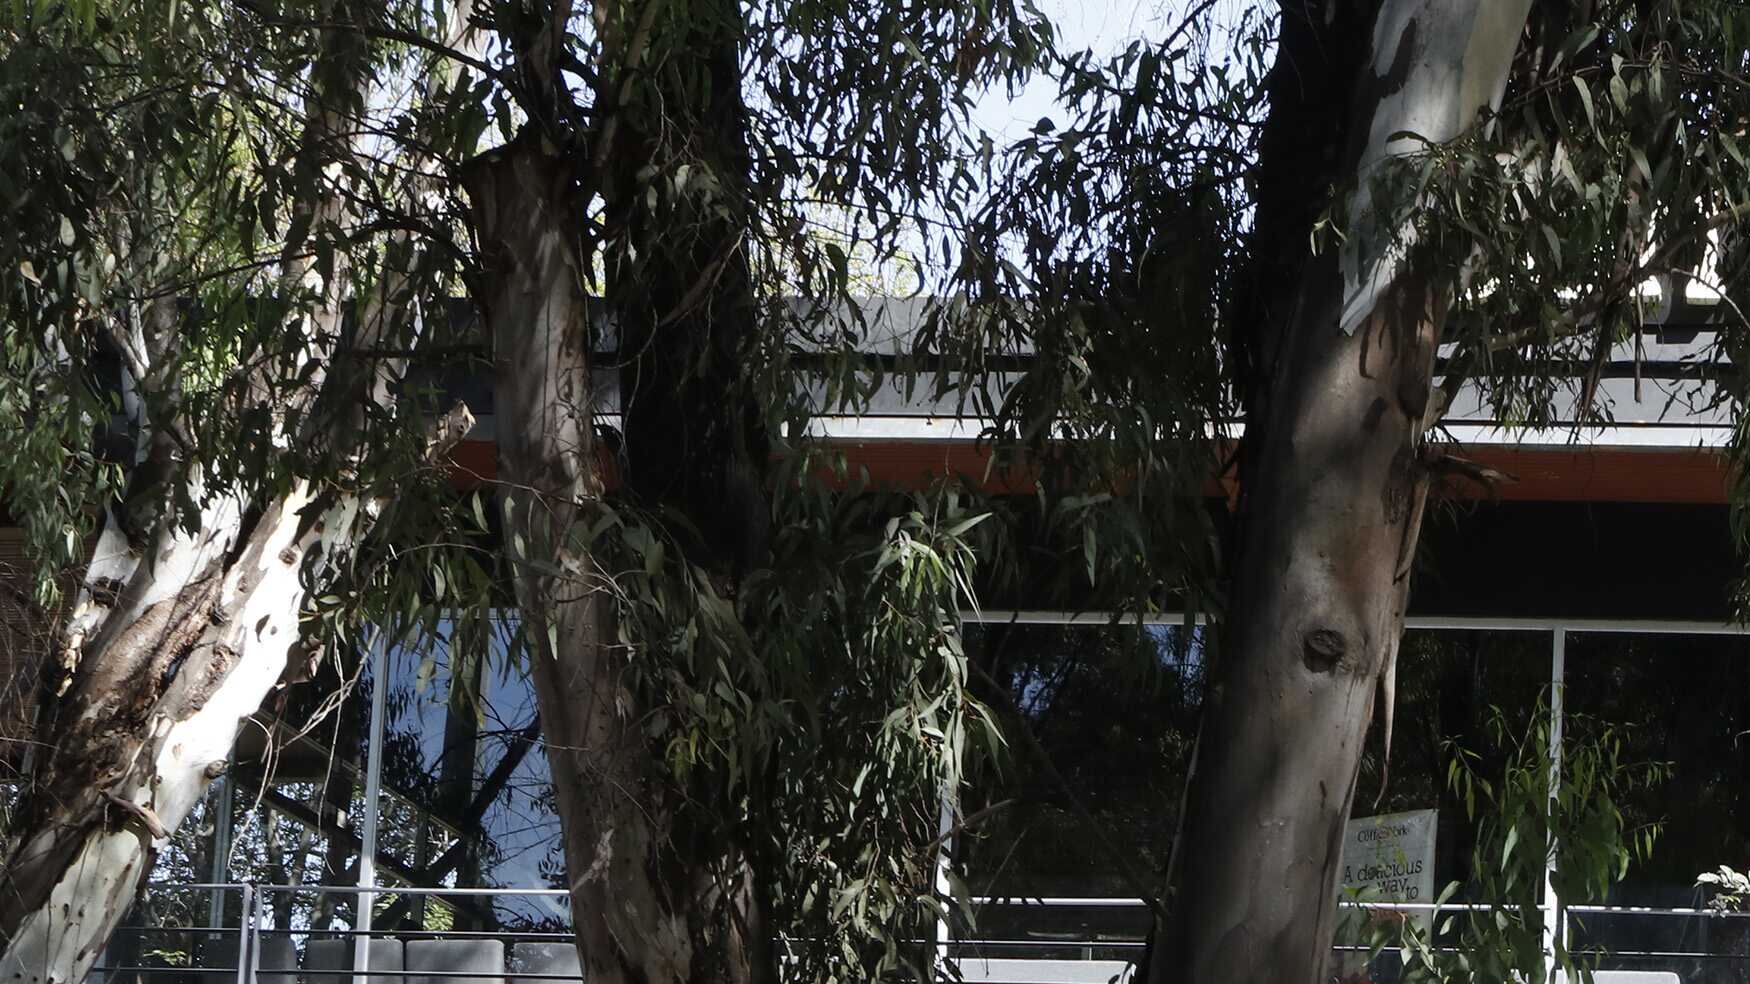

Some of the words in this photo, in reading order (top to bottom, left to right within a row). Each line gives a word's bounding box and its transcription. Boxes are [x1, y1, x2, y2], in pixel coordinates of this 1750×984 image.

[1357, 859, 1423, 882] deicious
[1377, 878, 1408, 894] way
[1406, 885, 1419, 900] to
